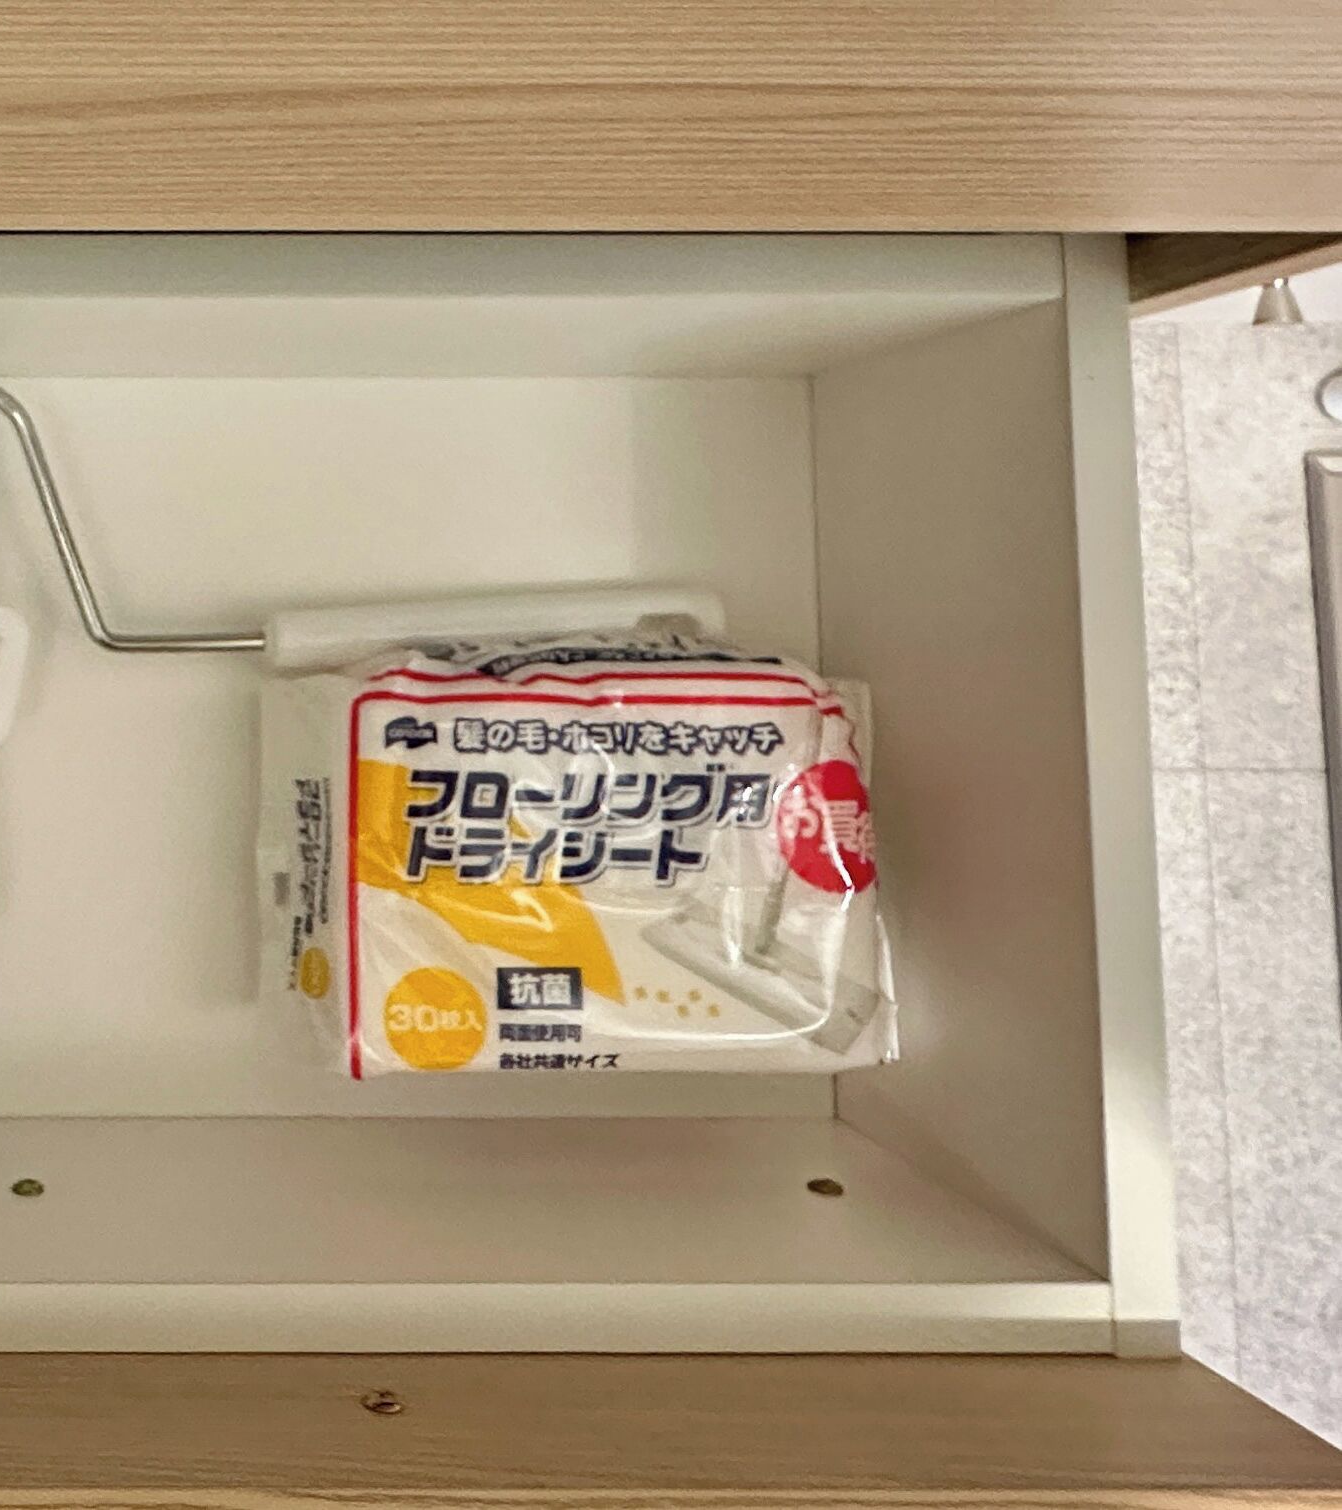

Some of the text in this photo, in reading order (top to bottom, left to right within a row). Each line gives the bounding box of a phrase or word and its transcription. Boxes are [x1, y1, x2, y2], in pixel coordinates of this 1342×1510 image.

[406, 763, 777, 828] フローリング用
[406, 823, 708, 885] ドライシート
[509, 972, 573, 1007] 抗菌
